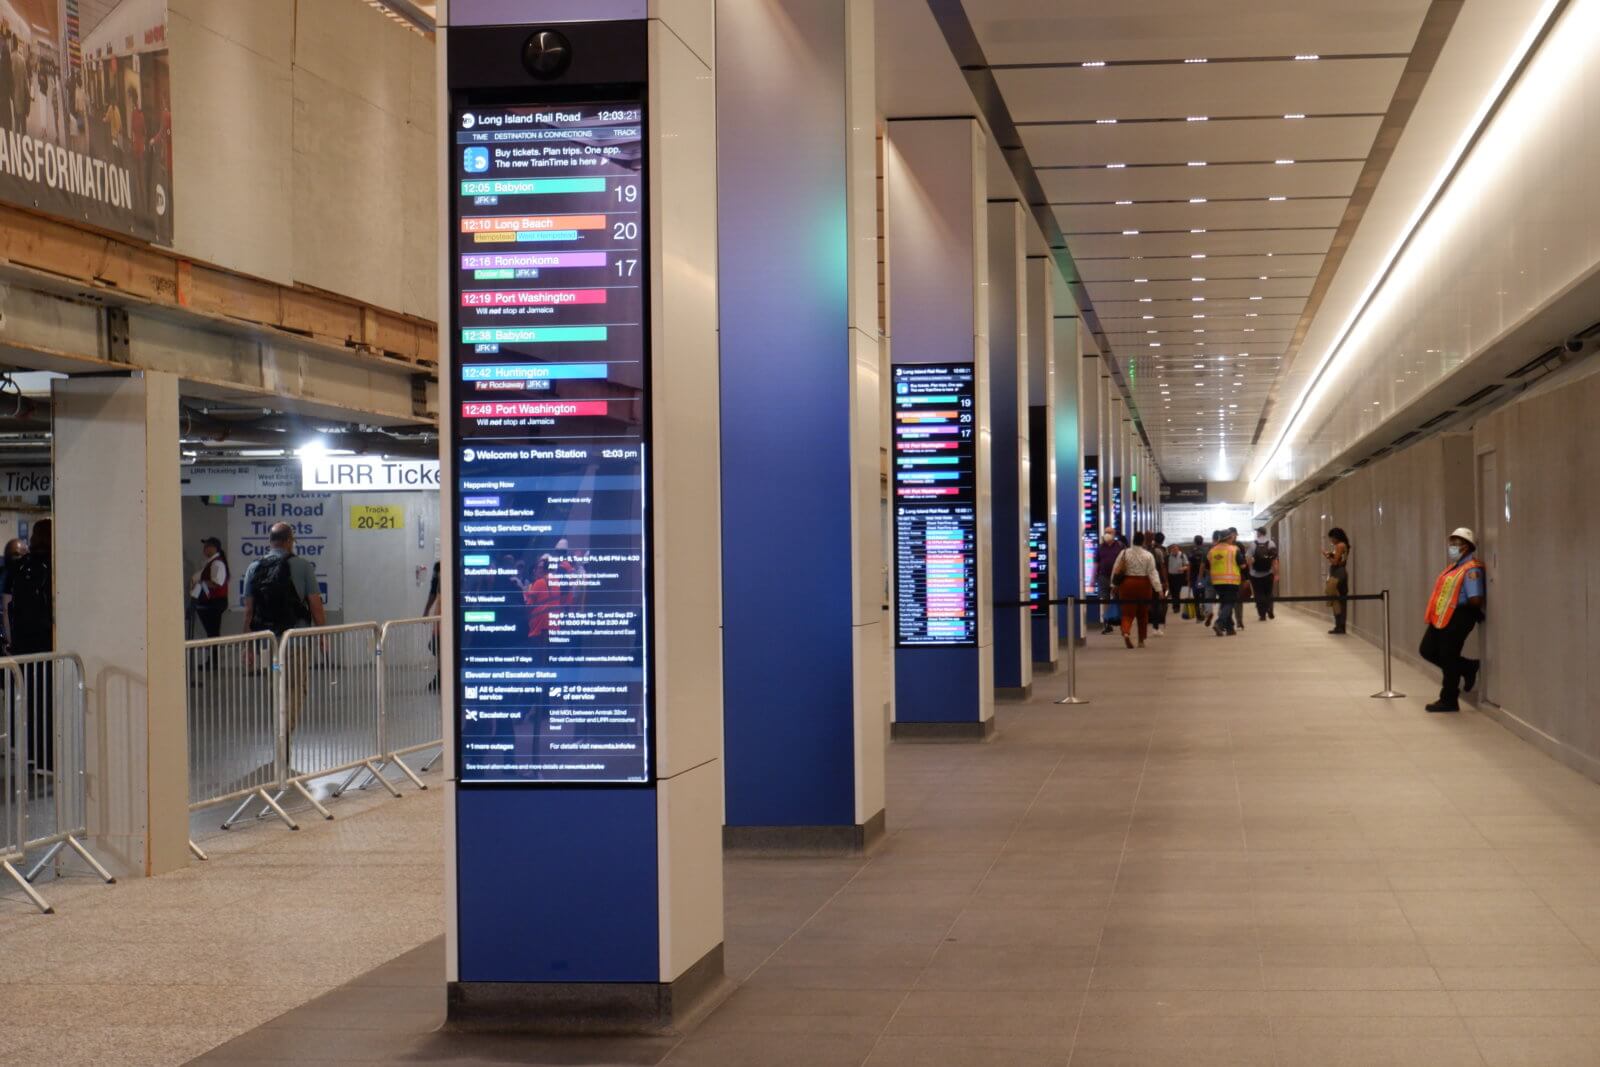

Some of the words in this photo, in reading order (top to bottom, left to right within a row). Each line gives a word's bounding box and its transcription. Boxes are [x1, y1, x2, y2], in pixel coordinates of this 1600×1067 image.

[479, 116, 502, 126] Long
[505, 114, 533, 124] Island
[535, 114, 552, 122] Rail
[556, 112, 580, 122] Road
[598, 111, 637, 121] 12:03:21
[495, 132, 536, 140] DESTINATION
[495, 149, 510, 158] Buy
[513, 148, 541, 156] tickets.
[543, 147, 560, 155] Plan
[563, 147, 582, 156] trips.
[584, 146, 601, 154] One
[495, 160, 510, 168] The
[531, 158, 568, 167] TrainTime
[578, 158, 597, 166] here
[464, 184, 490, 193] 12:05
[495, 183, 534, 192] Babylon
[614, 185, 637, 202] 19
[475, 196, 490, 204] JFK
[464, 220, 490, 230] 12:10
[495, 220, 519, 229] Long
[522, 218, 552, 228] Beach
[537, 232, 576, 240] Hempstead
[613, 223, 637, 239] 20
[477, 233, 514, 242] Hempstead
[495, 256, 559, 265] Ronkonkoma
[615, 260, 637, 277] 17
[464, 294, 491, 303] 12:19
[495, 293, 515, 303] Port
[518, 292, 575, 303] Washington
[495, 331, 535, 341] Babylon
[464, 369, 490, 377] 12:42
[495, 367, 549, 377] Huntington
[489, 381, 524, 389] Rockaway
[465, 405, 492, 414] 12:49
[495, 405, 516, 413] Port
[519, 403, 576, 414] Washington
[477, 451, 518, 460] Welcome
[531, 450, 553, 459] Penn
[555, 450, 586, 458] Station
[602, 450, 623, 458] 12:03
[624, 450, 637, 459] pm
[315, 464, 372, 484] LIRR
[464, 482, 498, 490] Happening
[245, 504, 276, 516] Rail
[281, 503, 323, 516] Road
[358, 516, 395, 528] 20-21
[242, 543, 324, 555] Cusmer
